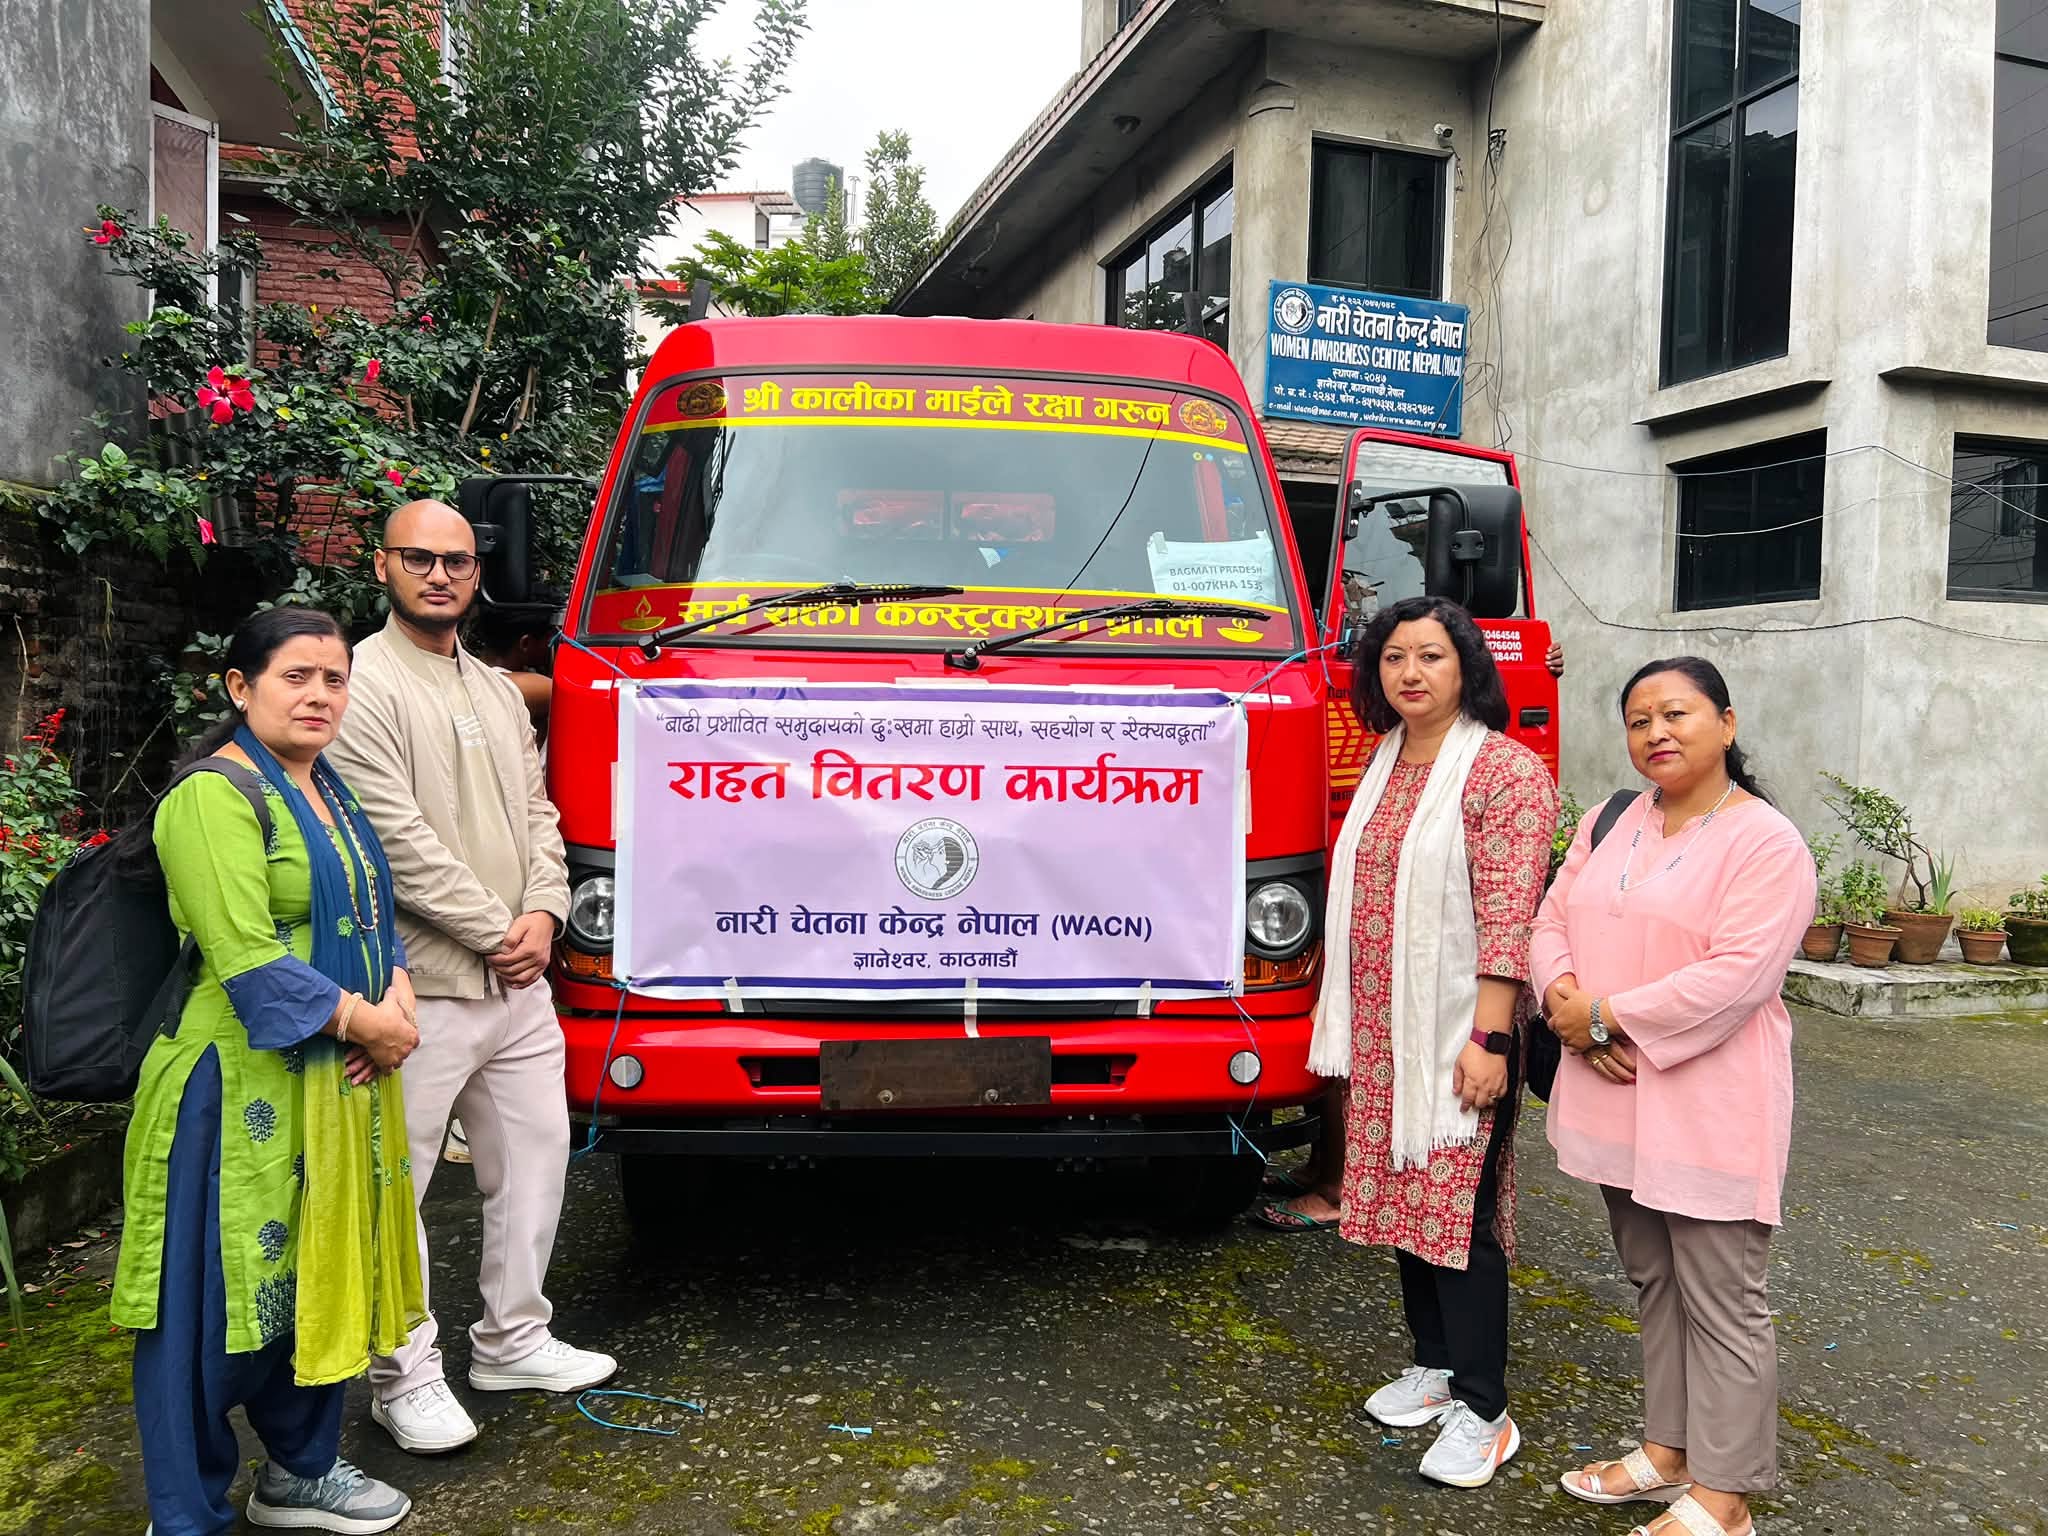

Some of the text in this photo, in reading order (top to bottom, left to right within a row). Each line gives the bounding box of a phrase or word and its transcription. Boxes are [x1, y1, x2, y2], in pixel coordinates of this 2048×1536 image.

[1317, 303, 1351, 335] नारी
[1353, 305, 1395, 341] चेतना
[1396, 311, 1430, 349] केन्द्र
[1430, 315, 1464, 349] नेपाल
[1271, 333, 1310, 360] WOMEN
[1311, 338, 1370, 366] AWARENESS
[1371, 346, 1412, 372] CENTRE
[1412, 351, 1442, 375] NEPAL
[743, 381, 783, 413] श्री
[791, 381, 916, 412] कालीका
[925, 385, 1014, 416] माईले
[1023, 393, 1085, 420] रक्षा
[1169, 565, 1263, 577] BAGMATI PRADESH
[1172, 580, 1238, 591] 01-007KHA
[706, 708, 769, 737] प्रभावित
[774, 711, 866, 742] समुदायको
[870, 717, 933, 742] दुःखमा
[939, 713, 976, 740] हाम्रो
[981, 719, 1023, 740] साथ,
[1030, 715, 1095, 741] सहयोग
[1100, 721, 1117, 741] र
[667, 748, 1204, 806] राहत वितरण कार्यक्रम
[715, 904, 1153, 943] नारी चेतना केन्द्र नेपाल (WACN)
[853, 948, 931, 971] ज्ञानेश्वर,
